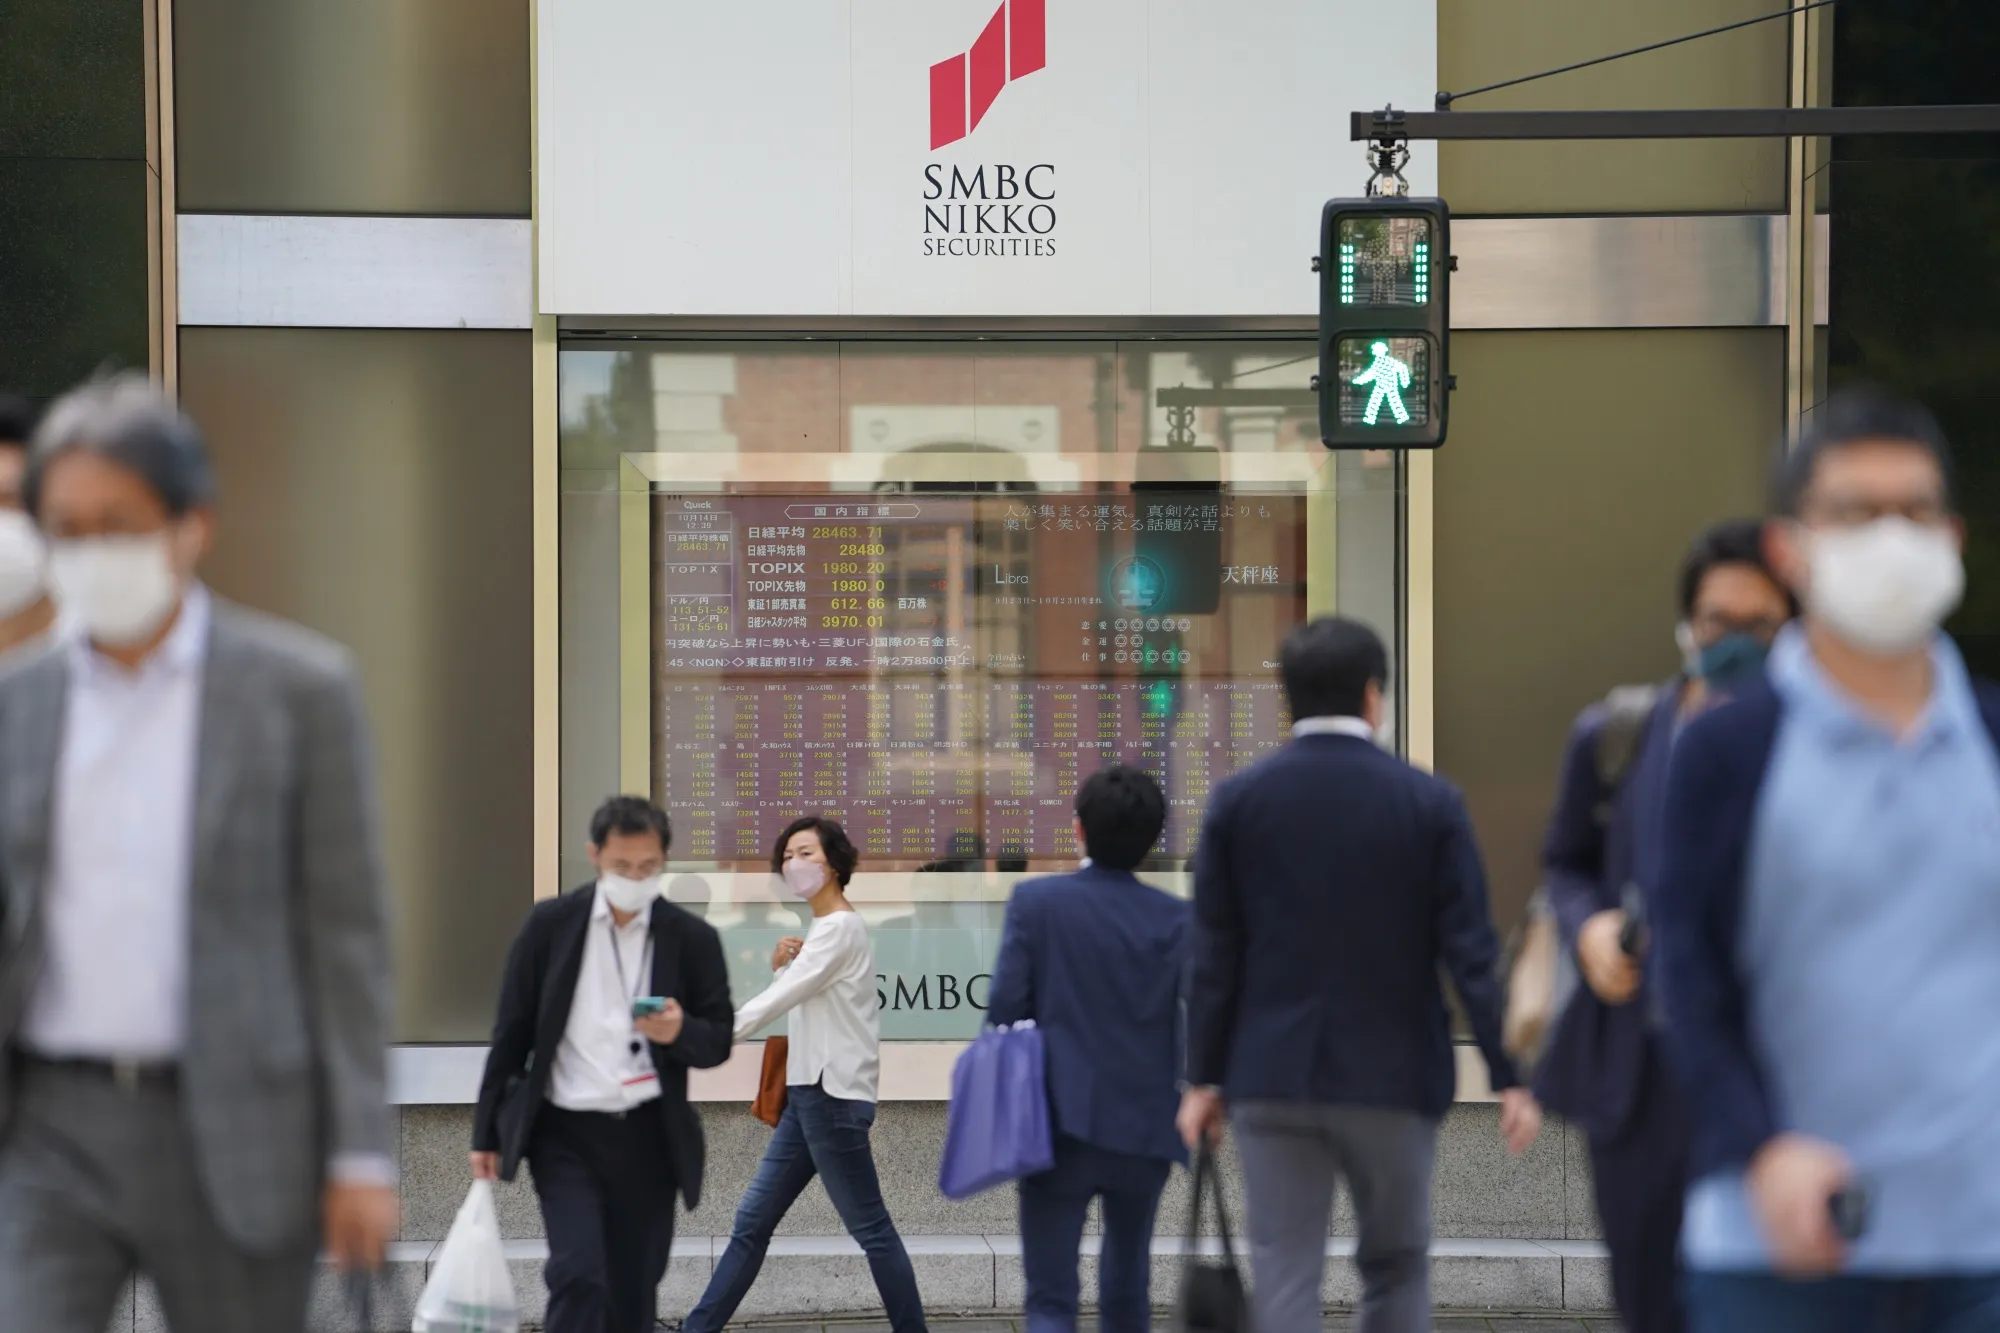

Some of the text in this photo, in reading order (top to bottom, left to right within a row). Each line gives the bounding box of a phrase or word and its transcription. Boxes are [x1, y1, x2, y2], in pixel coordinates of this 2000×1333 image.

[923, 163, 1056, 200] SMBC
[923, 204, 1056, 234] NIKKO
[923, 238, 1056, 256] SECURITIES
[684, 501, 712, 509] Quick
[814, 506, 890, 516] 国内指標
[1002, 518, 1225, 532] 楽しく笑い合える話題が吉。
[748, 526, 805, 538] 日経平均
[748, 544, 884, 556] 日経平均先物 28480
[748, 562, 805, 574] TOPIX
[996, 564, 1028, 584] Libra
[1222, 566, 1280, 584] 天秤座
[748, 580, 806, 592] TOPIX先物
[898, 598, 926, 610] 百万株
